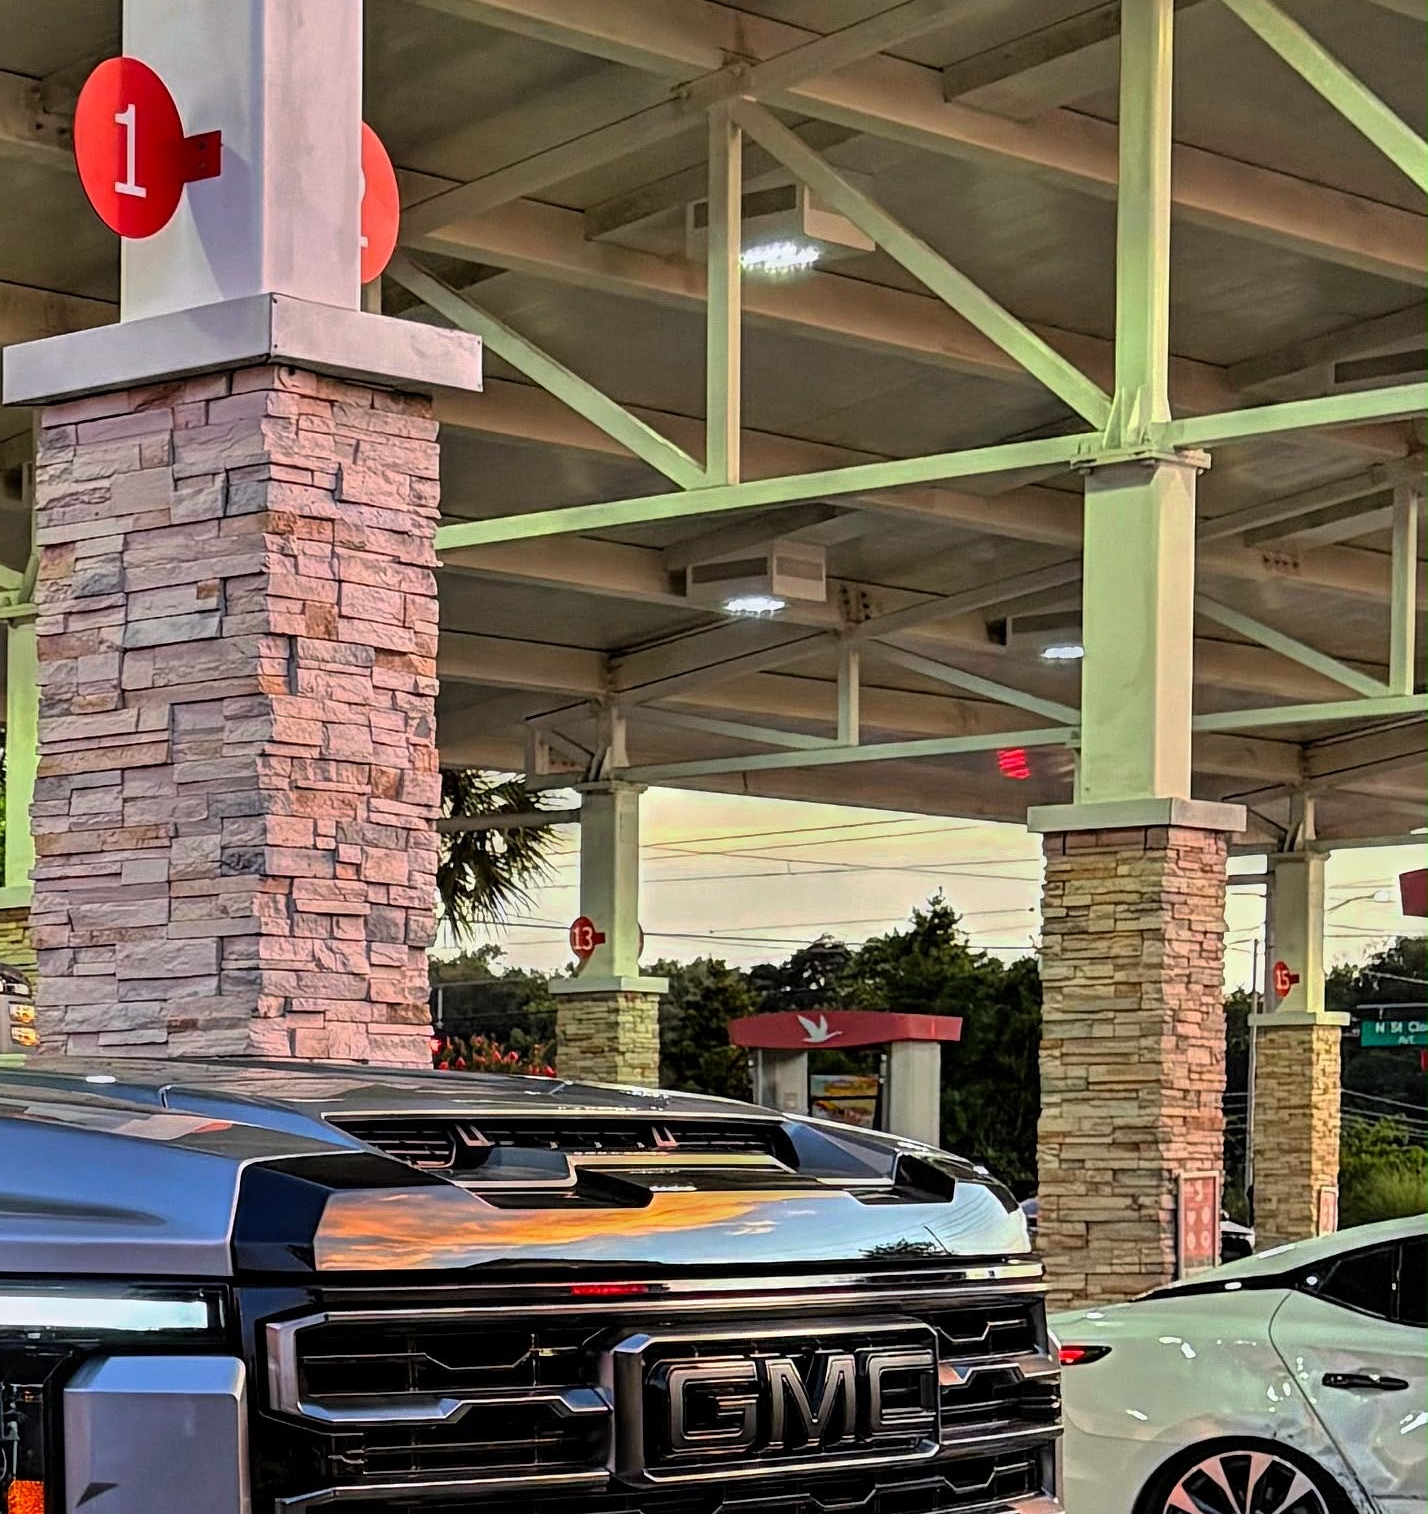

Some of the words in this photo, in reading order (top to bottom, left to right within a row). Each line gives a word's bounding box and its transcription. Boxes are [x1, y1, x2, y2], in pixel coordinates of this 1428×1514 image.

[114, 103, 147, 199] 1
[573, 926, 593, 951] 13
[1276, 969, 1290, 990] 15
[663, 1347, 937, 1454] GMC
